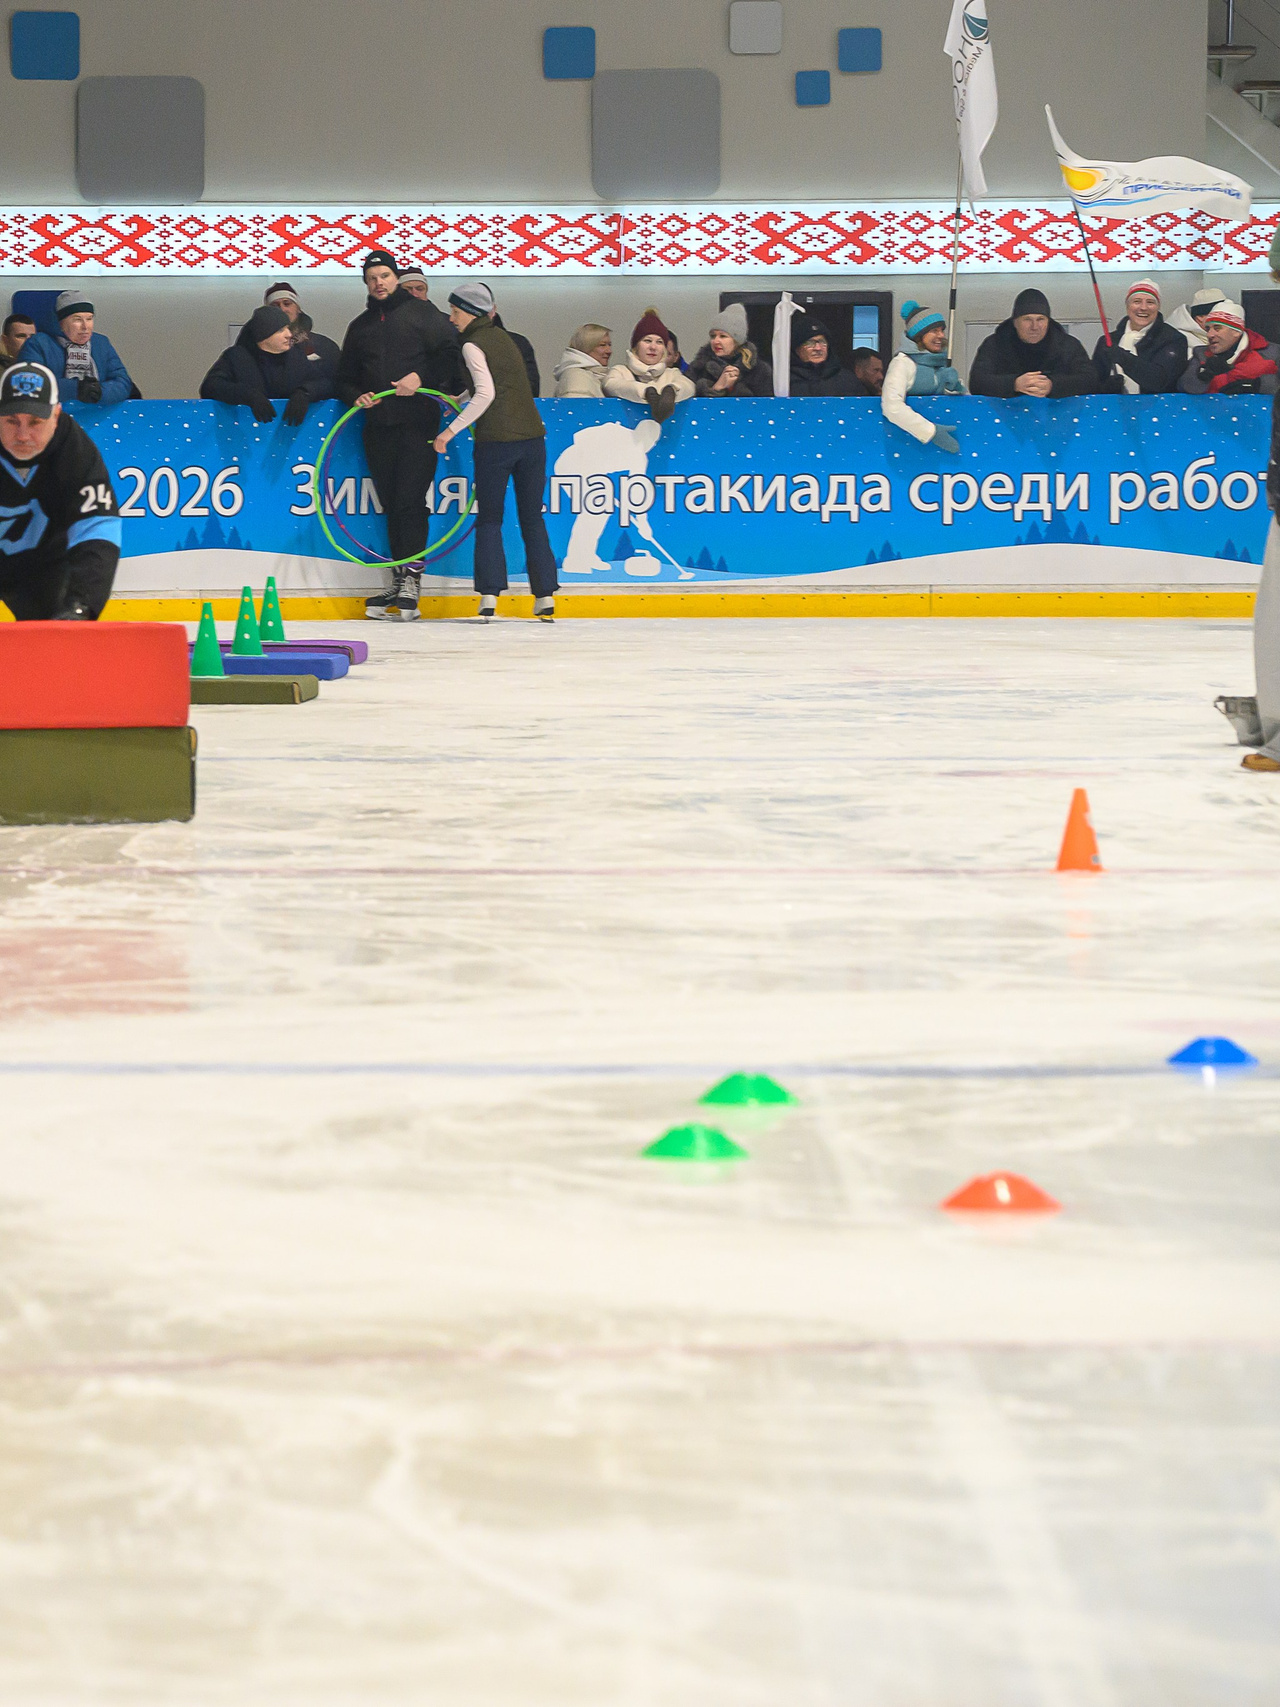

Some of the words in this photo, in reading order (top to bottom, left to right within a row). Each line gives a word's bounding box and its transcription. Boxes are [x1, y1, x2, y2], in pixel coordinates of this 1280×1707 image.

[79, 484, 113, 513] 24
[118, 465, 244, 518] 2026
[289, 463, 478, 516] Зимя
[540, 473, 892, 527] партакиада
[908, 472, 1089, 525] среди
[1109, 455, 1269, 525] рабо
